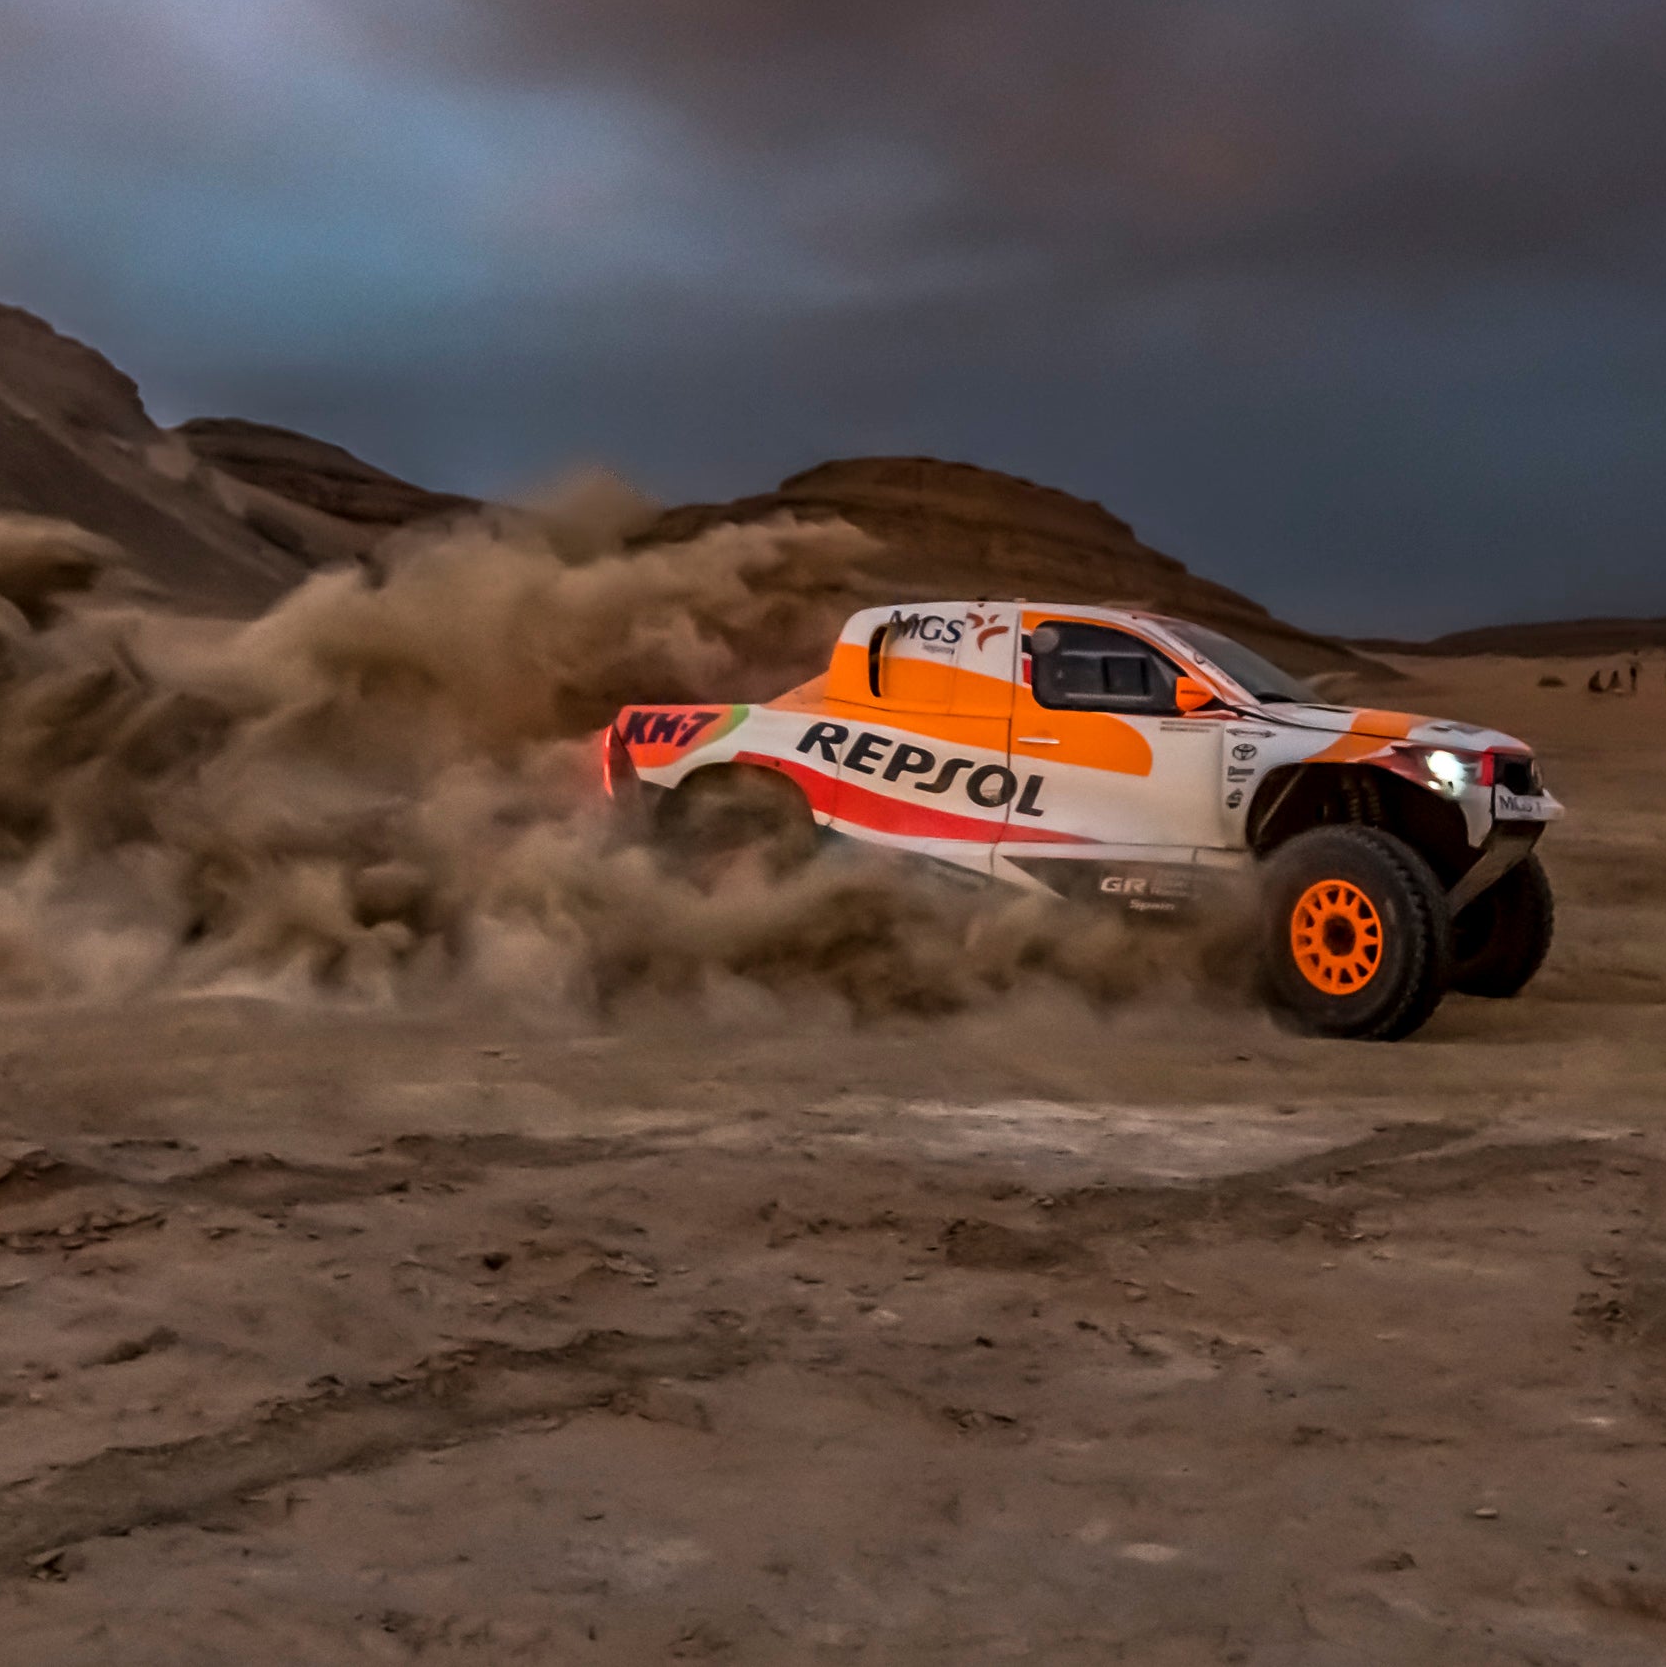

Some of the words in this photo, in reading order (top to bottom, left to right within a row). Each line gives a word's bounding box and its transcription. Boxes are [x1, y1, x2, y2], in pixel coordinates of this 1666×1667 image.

[889, 610, 965, 643] MGS
[796, 721, 1044, 817] REPSOL
[1100, 876, 1147, 893] GR
